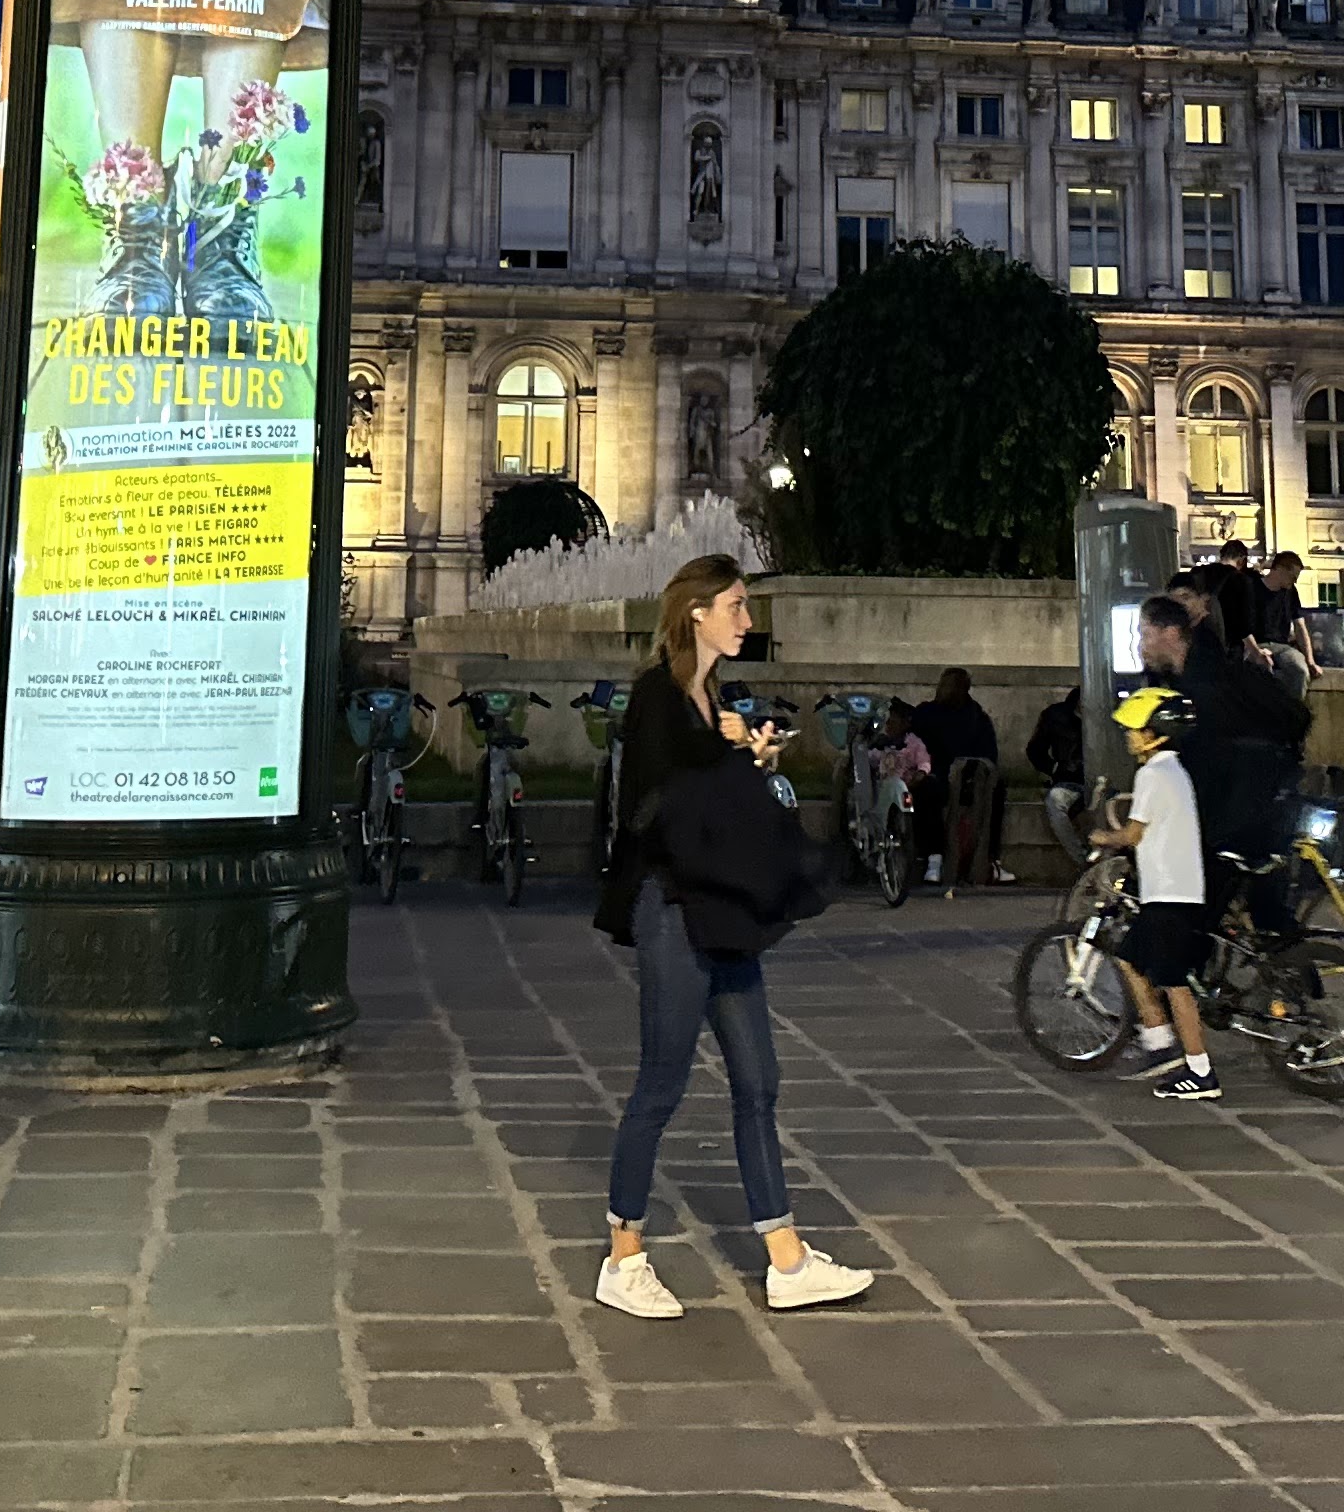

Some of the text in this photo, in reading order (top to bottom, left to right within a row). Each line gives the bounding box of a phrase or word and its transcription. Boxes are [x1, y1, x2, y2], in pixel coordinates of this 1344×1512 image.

[43, 315, 310, 366] CHANGER L'EAU
[69, 363, 285, 410] DES FLEURS
[81, 428, 173, 446] nomination
[266, 424, 297, 438] 2022
[142, 442, 193, 454] FÉMININE
[197, 440, 248, 451] CAROLINE
[251, 439, 299, 450] ROCHEFORT
[115, 475, 159, 487] Acteurs
[127, 491, 153, 502] fleur
[158, 490, 173, 500] de
[215, 484, 271, 497] TÉLÉRAMA
[149, 505, 163, 517] LE
[169, 503, 226, 516] PARISIEN
[151, 523, 162, 533] la
[167, 522, 183, 532] vie
[196, 519, 210, 531] LE
[215, 517, 258, 530] FIGARO
[209, 534, 250, 547] MATCH
[89, 559, 120, 571] Coup
[125, 557, 139, 568] de
[217, 550, 246, 563] INFO
[99, 574, 129, 587] leçon
[216, 567, 230, 579] LA
[234, 564, 284, 578] TERRASSE
[125, 598, 203, 608] Mise en scène
[32, 607, 286, 622] SALOMÉ LELOUCH & MIKAËL CHIRINIAN
[97, 660, 222, 671] CAROLINE ROCHEFORT
[28, 674, 69, 685] MORGAN
[72, 674, 104, 684] PEREZ
[201, 672, 239, 684] MIKAËL
[15, 686, 58, 698] FRÉDÉRIC
[60, 688, 108, 698] CHEVAUX
[204, 688, 258, 698] JEAN-PAUL
[115, 772, 133, 787] 01
[138, 772, 160, 787] 42
[164, 771, 188, 787] 08
[193, 771, 209, 786] 18
[213, 770, 236, 786] 50
[70, 789, 234, 803] theatredelarenaissance.com
